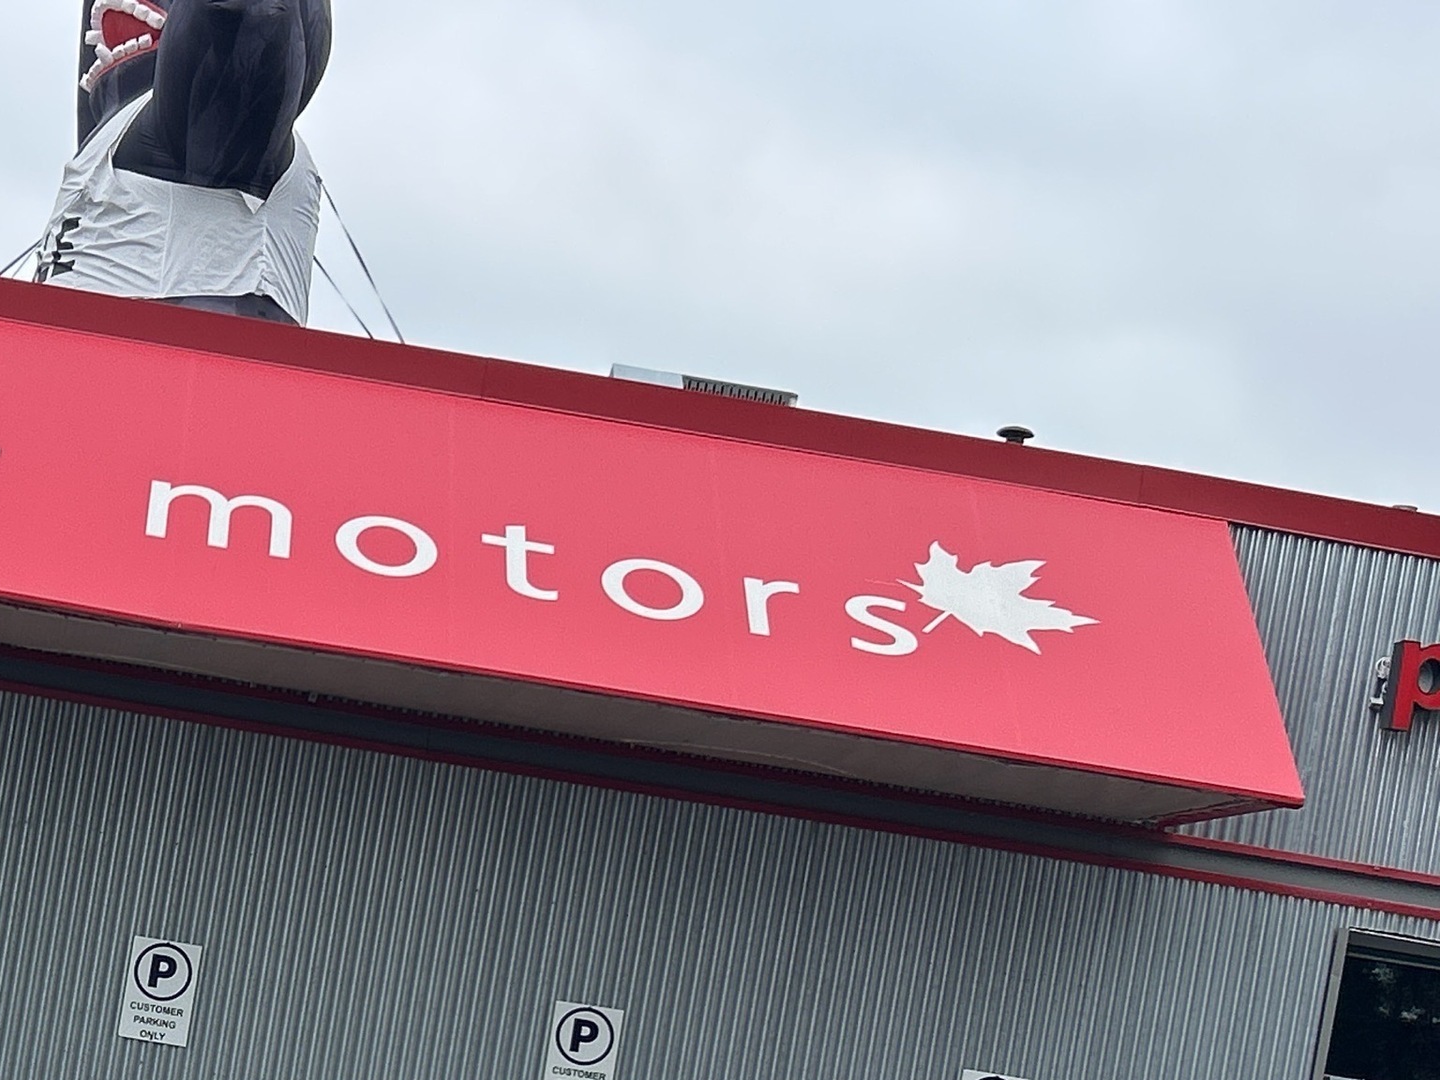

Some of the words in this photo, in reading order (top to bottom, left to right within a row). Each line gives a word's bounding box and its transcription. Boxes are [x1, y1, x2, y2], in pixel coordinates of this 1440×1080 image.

[145, 481, 918, 656] motors
[147, 953, 177, 988] P
[129, 1001, 184, 1017] CUSTOMER
[133, 1015, 176, 1030] PARKING
[139, 1029, 166, 1040] ONLY
[569, 1018, 599, 1053] P
[552, 1066, 606, 1080] CUSTOMER
